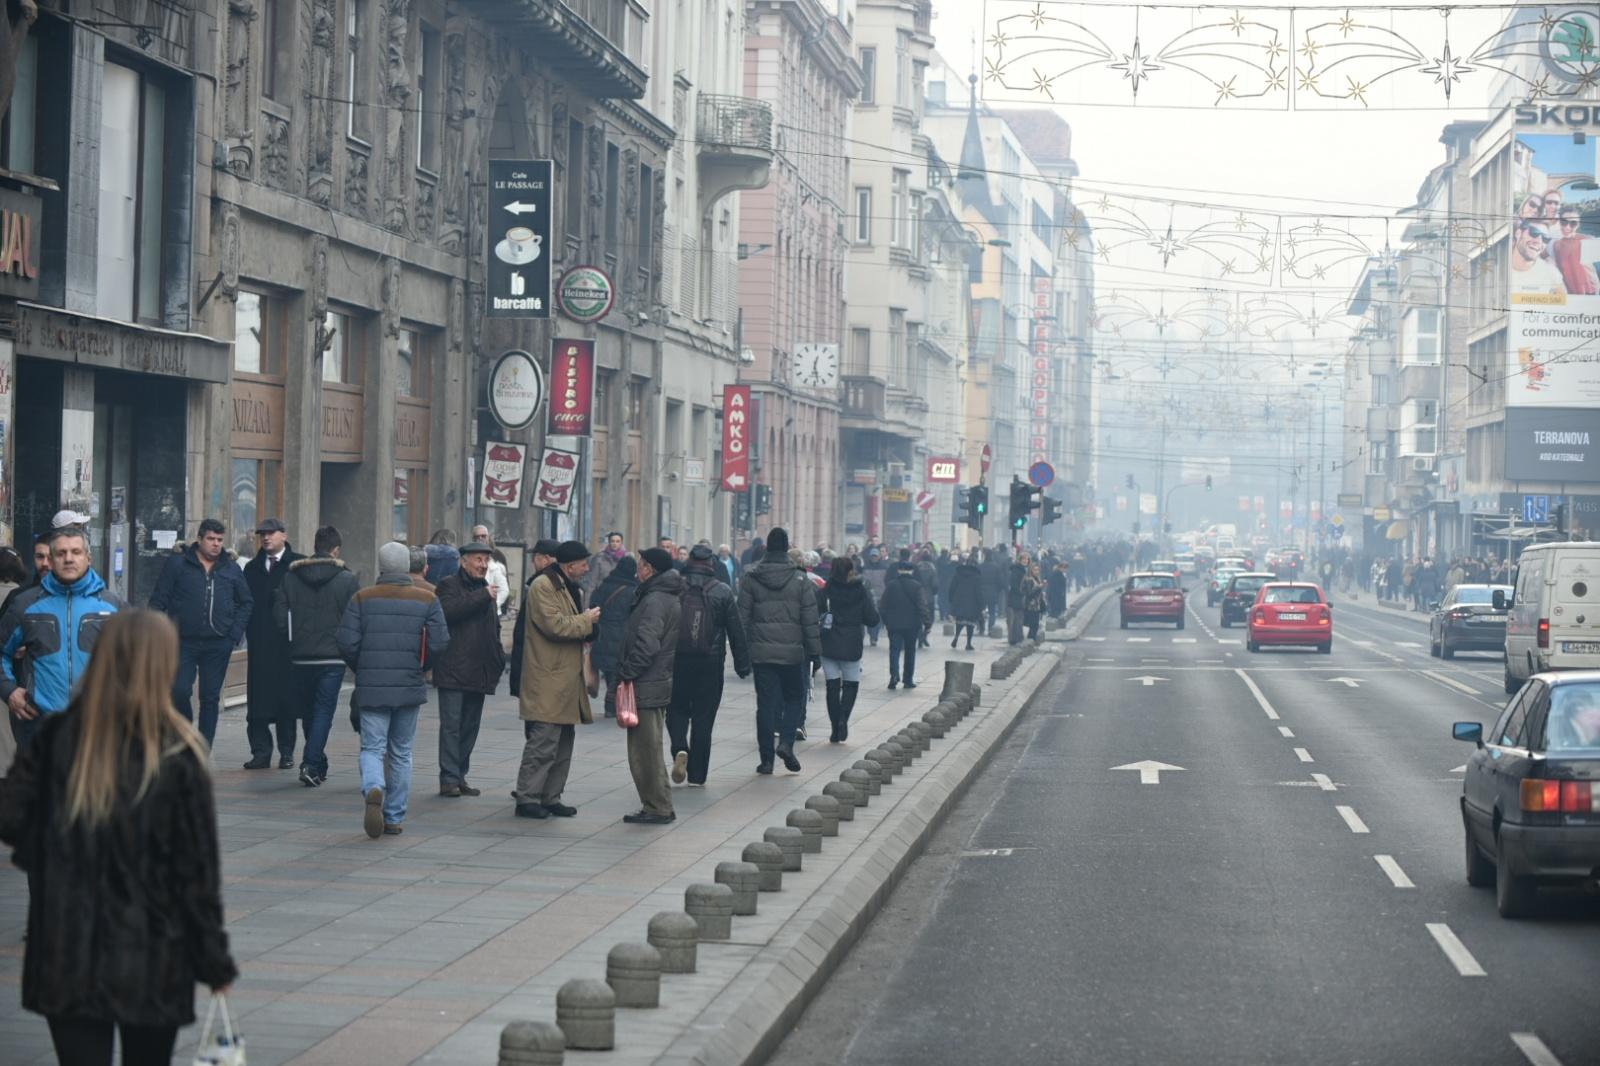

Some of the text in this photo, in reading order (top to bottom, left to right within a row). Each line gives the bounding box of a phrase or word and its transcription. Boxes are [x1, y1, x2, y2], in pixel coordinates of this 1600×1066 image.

[495, 181, 544, 189] LE PASSAGE
[564, 288, 606, 299] Heineken
[1523, 313, 1540, 324] For
[1543, 315, 1550, 324] a
[564, 346, 578, 409] BISTRO
[729, 393, 745, 453] AMKO
[1534, 431, 1590, 445] TERRANOVA
